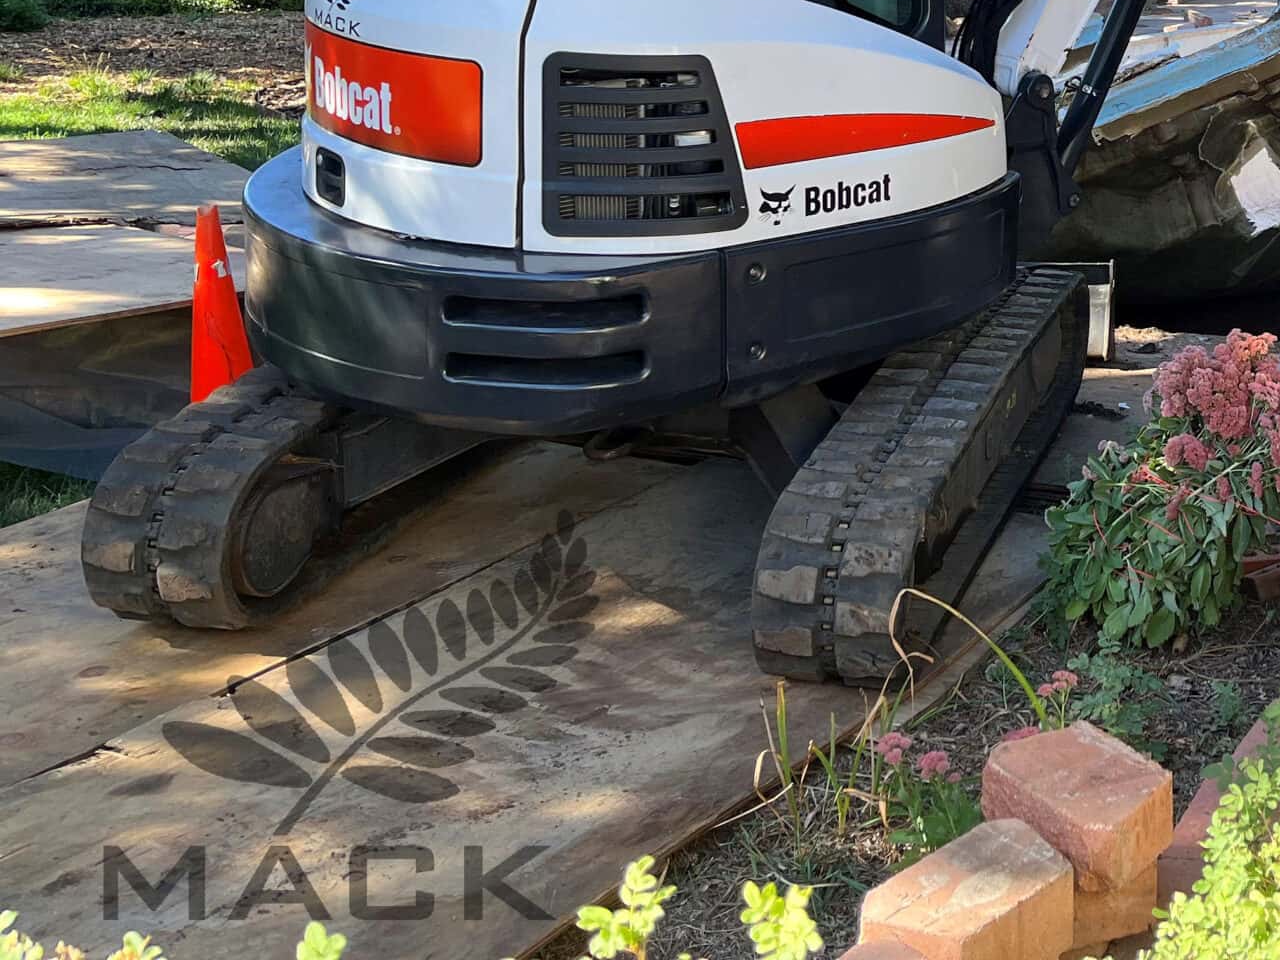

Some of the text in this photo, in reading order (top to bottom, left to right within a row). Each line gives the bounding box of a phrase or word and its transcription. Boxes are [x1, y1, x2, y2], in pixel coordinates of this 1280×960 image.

[314, 8, 361, 38] MACK
[314, 55, 393, 135] Bobcat
[804, 173, 892, 217] Bobcat
